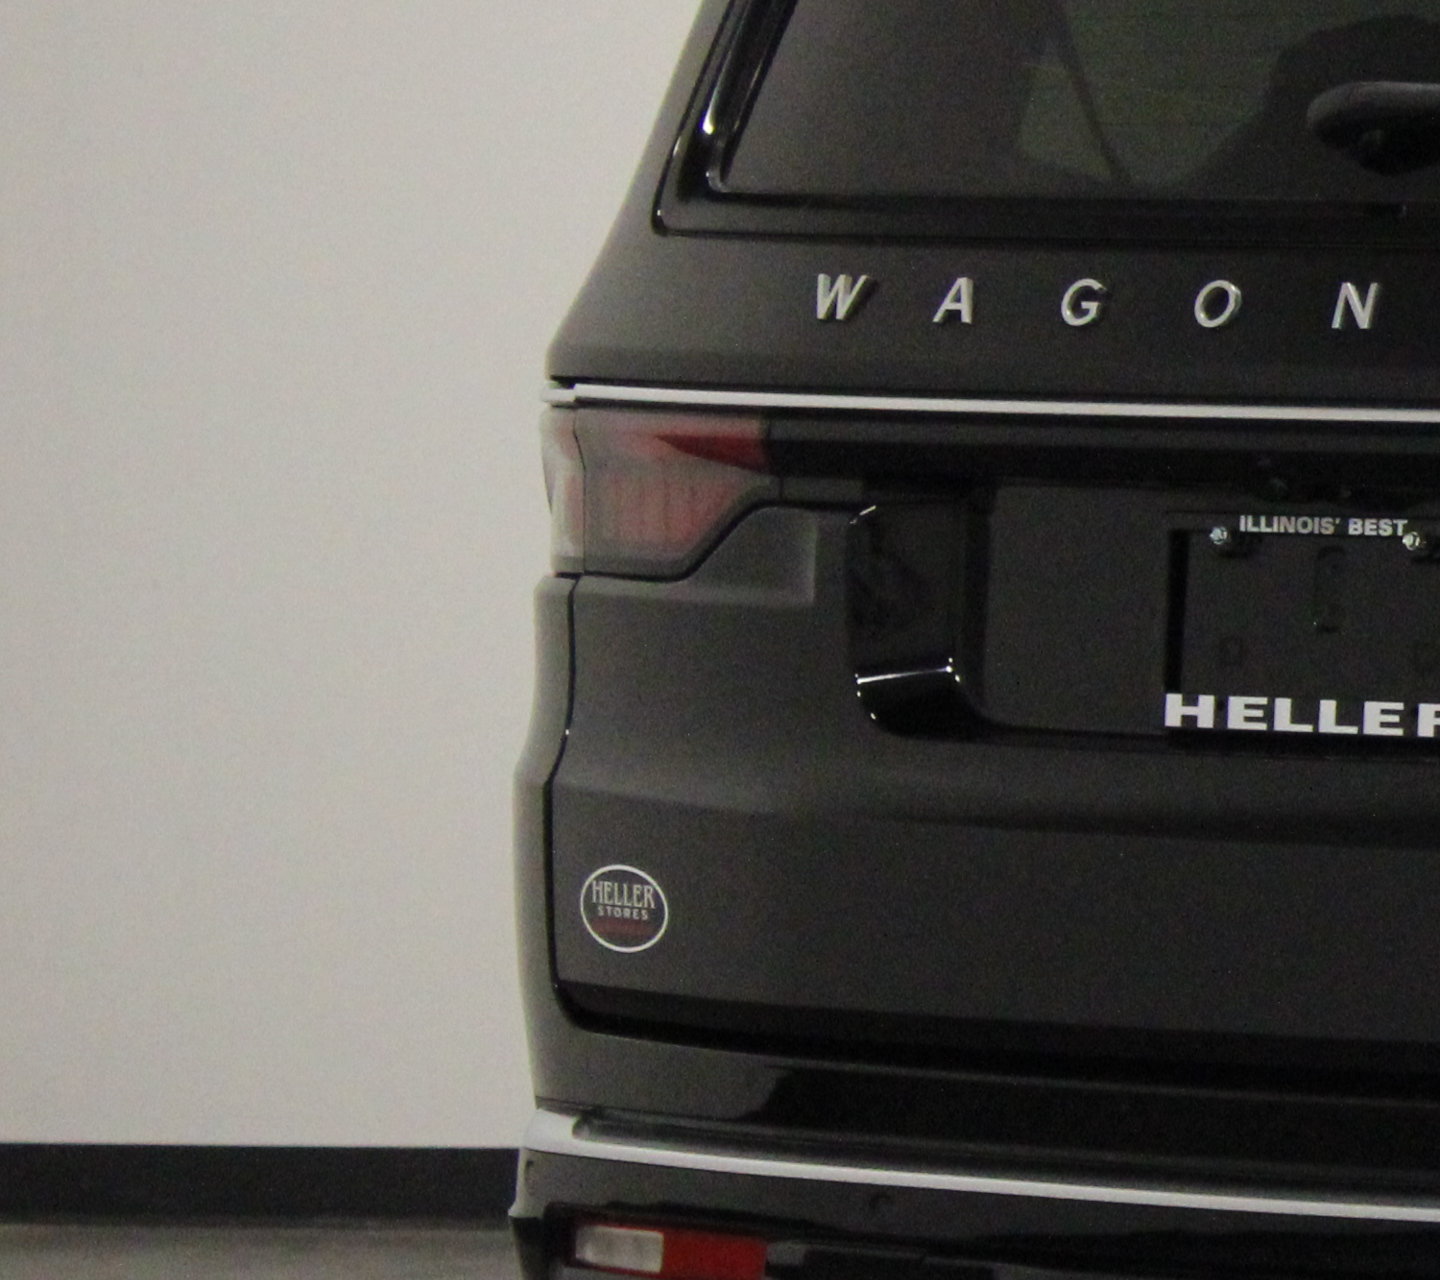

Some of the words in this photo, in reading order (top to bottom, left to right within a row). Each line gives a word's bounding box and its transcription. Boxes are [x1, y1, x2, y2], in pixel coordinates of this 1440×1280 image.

[1239, 514, 1341, 535] ILLINOIS'
[1347, 517, 1408, 537] BEST
[592, 880, 656, 909] HELLER
[597, 905, 649, 920] STORES
